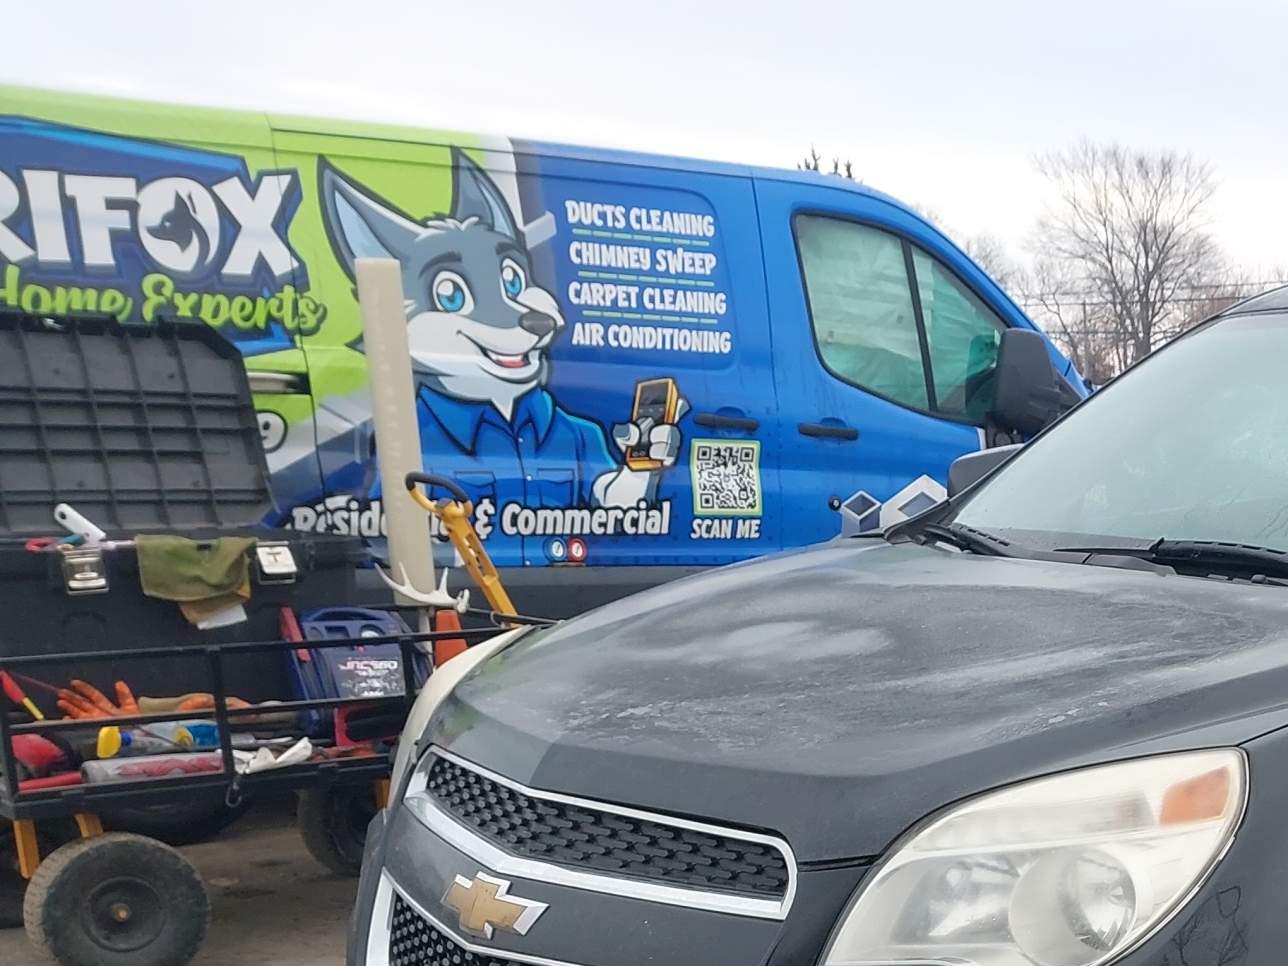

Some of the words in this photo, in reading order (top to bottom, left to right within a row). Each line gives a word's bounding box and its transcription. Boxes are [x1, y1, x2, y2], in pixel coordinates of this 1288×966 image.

[564, 199, 625, 229] DUCTS
[629, 207, 715, 237] CLEANING
[569, 241, 651, 271] CHIMNEY
[655, 247, 716, 275] SWEEP
[568, 281, 639, 308] CARPET
[642, 287, 726, 314] CLEANING
[572, 322, 604, 347] AIR
[607, 324, 732, 353] CONDITIONING
[475, 499, 496, 539] &
[501, 500, 672, 537] Commercial
[690, 518, 733, 540] SCAN
[735, 519, 762, 540] ME
